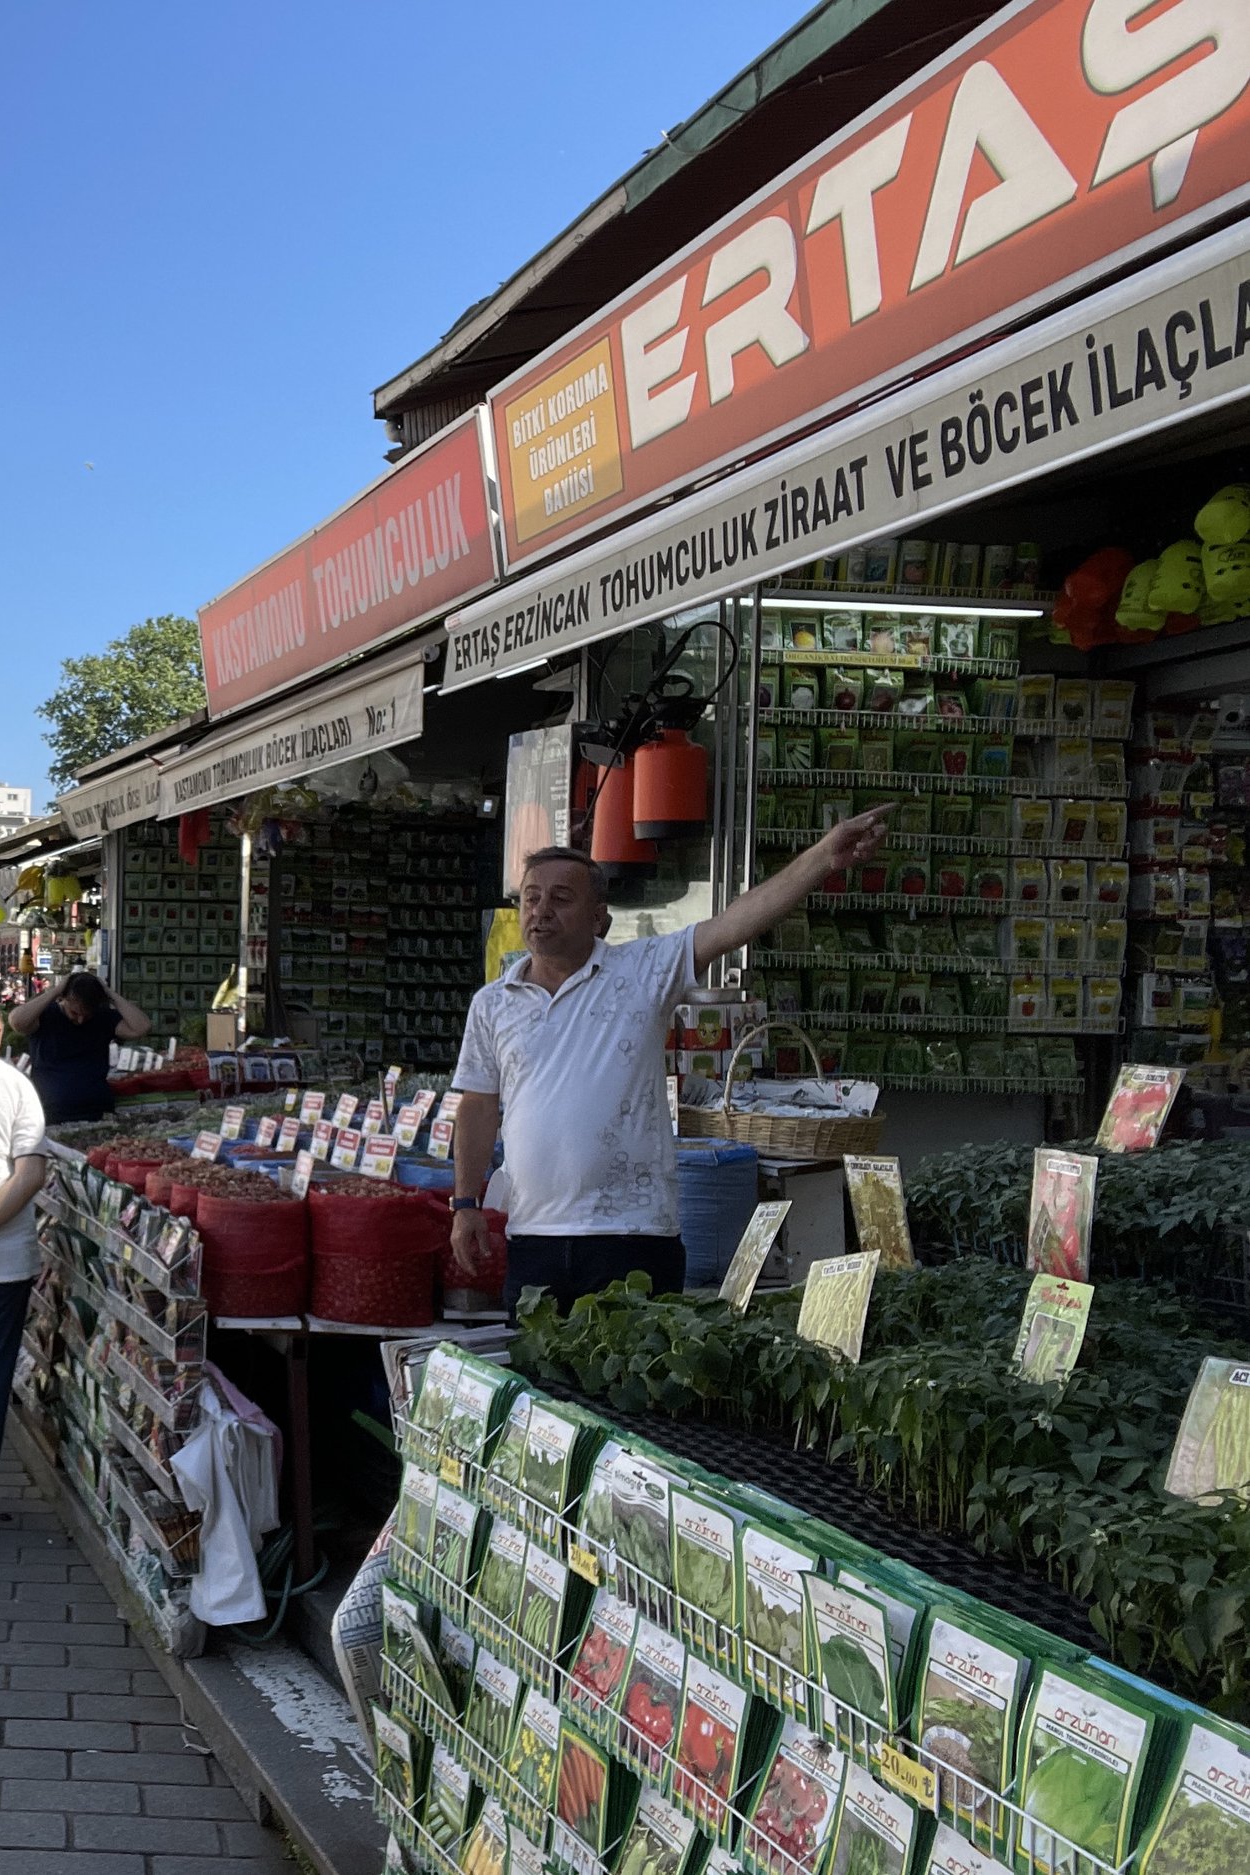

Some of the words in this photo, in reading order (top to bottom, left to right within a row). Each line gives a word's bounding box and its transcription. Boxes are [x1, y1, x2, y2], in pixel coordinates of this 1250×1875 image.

[619, 0, 1250, 451] ERTAŞ
[512, 397, 547, 449] BİTKİ
[547, 362, 610, 426] KORUMA
[528, 410, 597, 481] ÜRÜNLERİ
[454, 620, 500, 673] ERTAŞ
[503, 582, 591, 654] ERZİNCAN
[600, 507, 758, 617] TOHUMCULUK
[764, 455, 868, 551] ZİRAAT
[885, 429, 933, 499] VE
[940, 361, 1080, 478] BÖCEK
[211, 579, 306, 687] KASTAMONU
[312, 471, 471, 634] TOHUMCULUK
[265, 733, 298, 769] BÖCEK
[301, 716, 352, 761] İLAÇLARI
[945, 1652, 998, 1688] arzuman
[1055, 1707, 1119, 1750] arzuman
